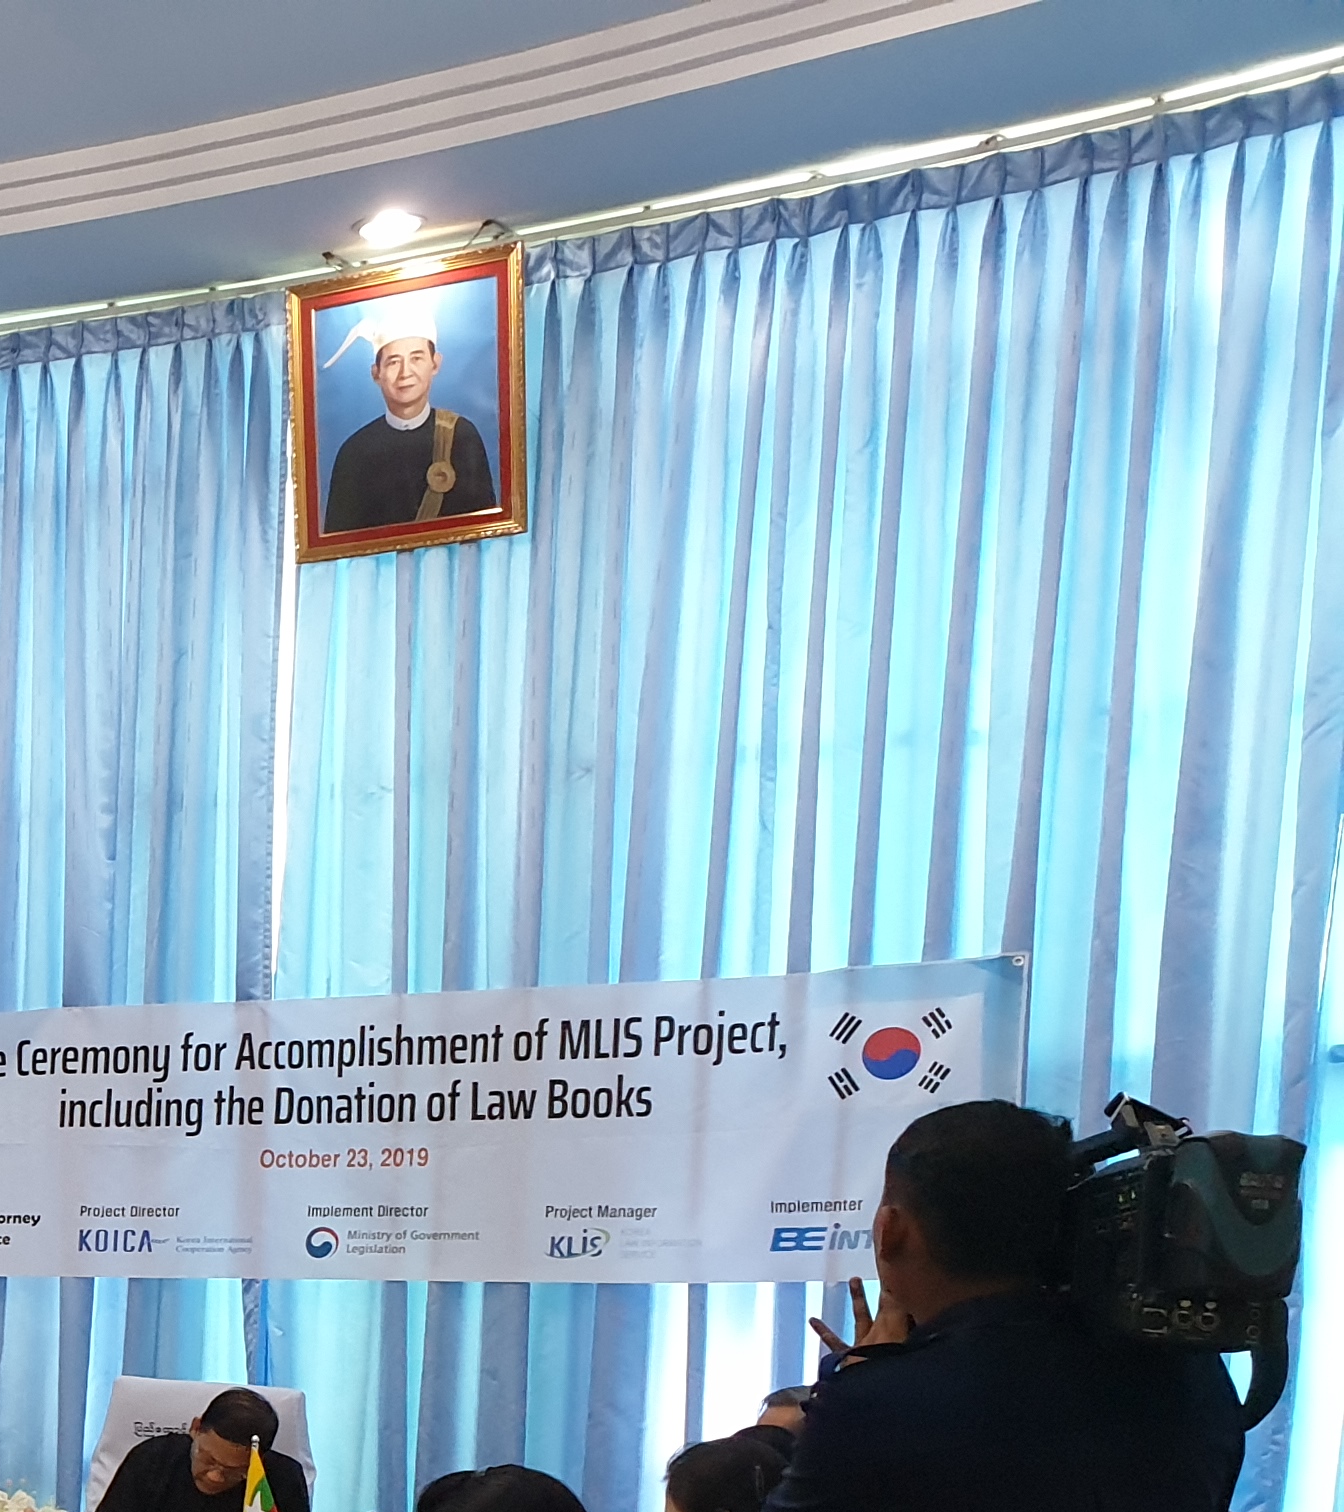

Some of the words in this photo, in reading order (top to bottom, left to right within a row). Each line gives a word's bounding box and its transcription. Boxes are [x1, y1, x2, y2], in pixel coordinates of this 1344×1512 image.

[16, 1040, 170, 1082] Ceremony
[180, 1032, 227, 1072] for
[234, 1023, 504, 1077] Accomplishment
[513, 1018, 549, 1062] of
[559, 1016, 643, 1061] MLIS
[653, 1010, 788, 1066] Project,
[59, 1087, 204, 1136] including
[214, 1085, 264, 1127] the
[274, 1082, 416, 1125] Donation
[426, 1079, 461, 1123] of
[470, 1081, 537, 1121] Law
[547, 1074, 652, 1119] Books
[259, 1148, 341, 1169] October
[346, 1148, 373, 1171] 23,
[380, 1147, 429, 1168] 2019
[79, 1205, 126, 1218] Project
[130, 1205, 180, 1218] Director
[307, 1204, 374, 1218] Implement
[377, 1204, 429, 1218] Director
[545, 1205, 593, 1221] Project
[597, 1204, 657, 1221] Manager
[770, 1199, 863, 1213] Implementer
[78, 1229, 153, 1253] KOICA
[347, 1230, 392, 1242] Ministry
[395, 1230, 407, 1240] of
[410, 1230, 480, 1241] Government
[346, 1244, 406, 1256] Legislation
